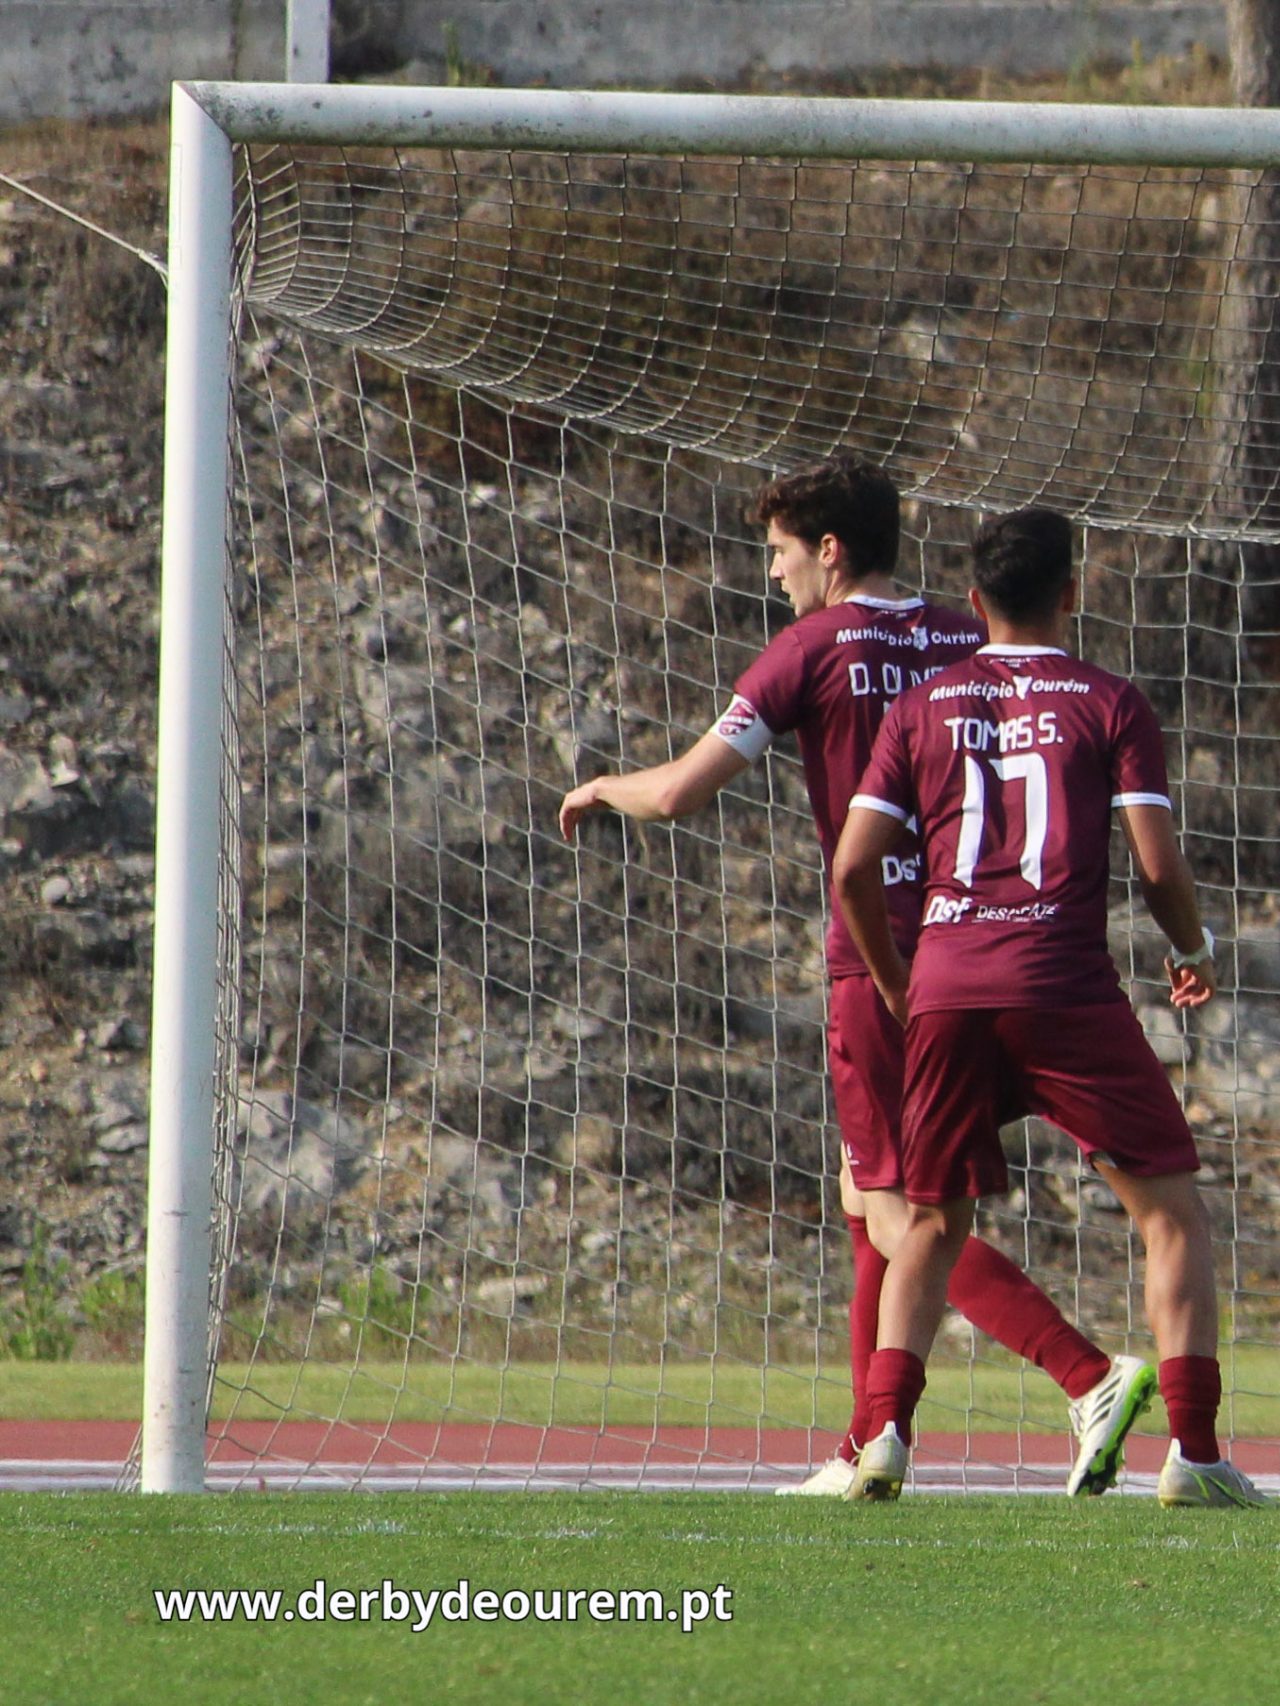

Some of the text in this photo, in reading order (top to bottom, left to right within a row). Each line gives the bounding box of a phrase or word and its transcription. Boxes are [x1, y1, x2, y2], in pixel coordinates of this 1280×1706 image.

[849, 662, 878, 696] D.
[944, 711, 1064, 752] TOMAS S.
[952, 752, 1048, 890] 17
